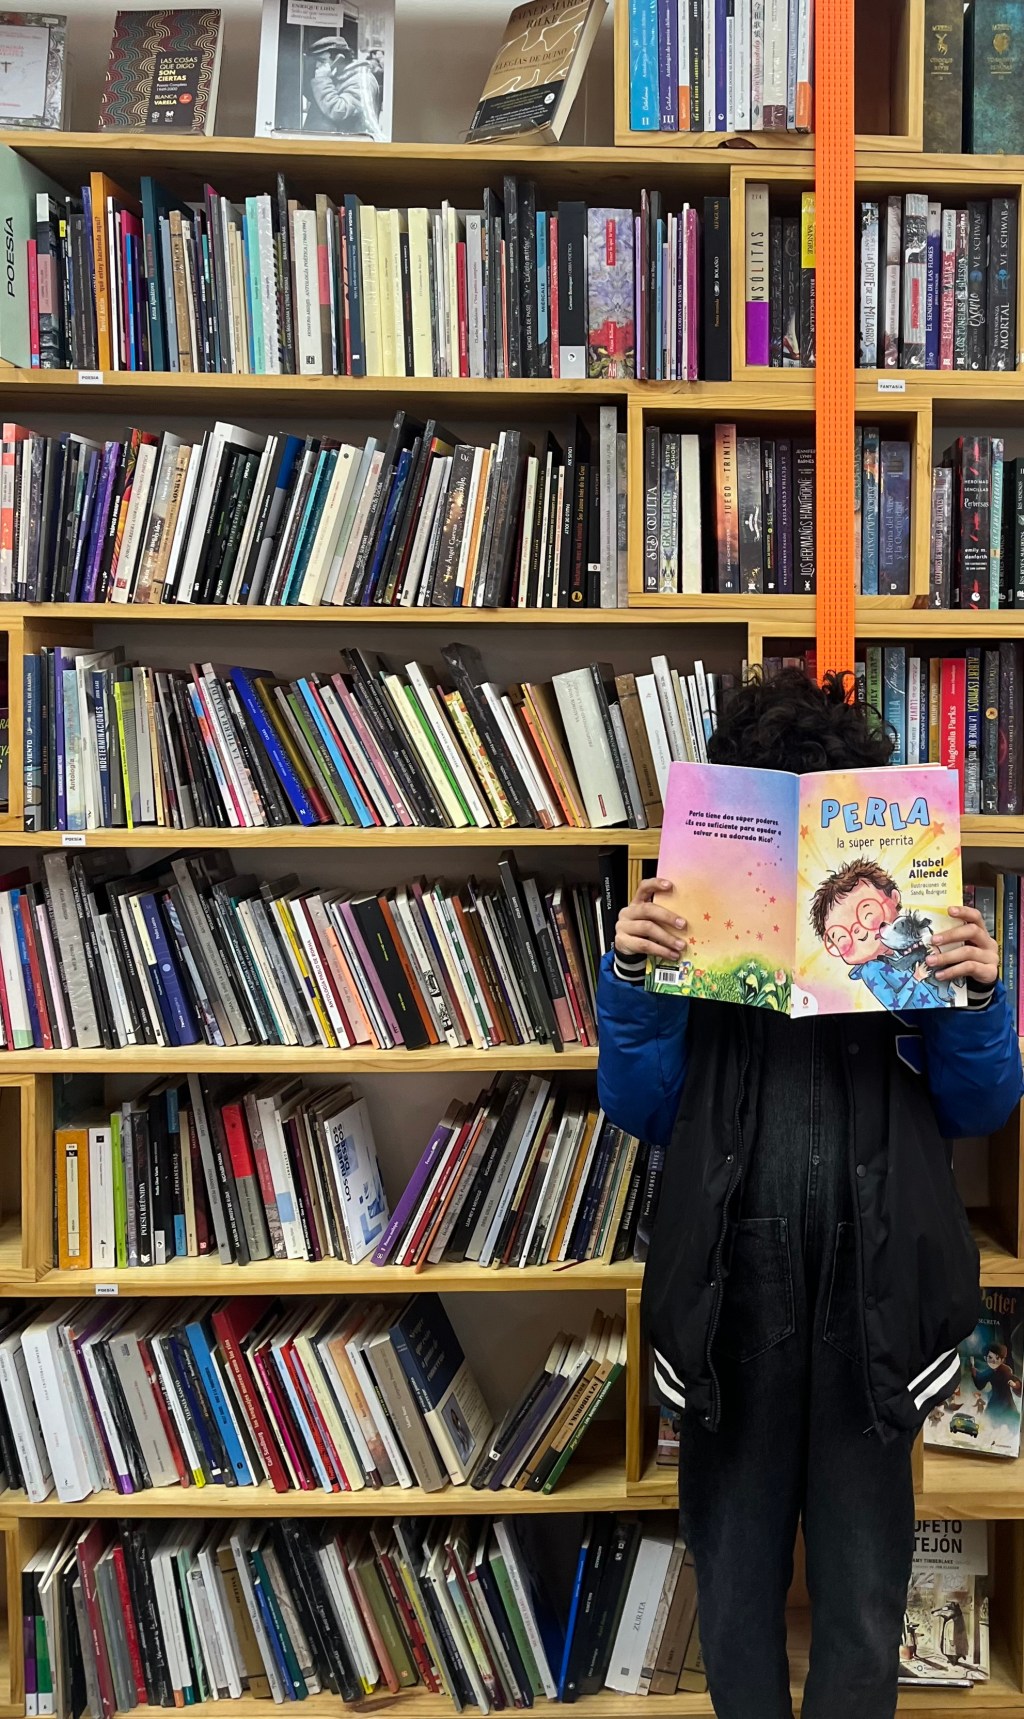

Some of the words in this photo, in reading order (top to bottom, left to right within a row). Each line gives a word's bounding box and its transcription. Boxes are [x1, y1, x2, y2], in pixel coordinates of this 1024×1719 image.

[495, 58, 527, 71] ELEGÍAS
[542, 49, 568, 60] DUINO
[7, 216, 15, 298] POESÍA
[863, 260, 874, 286] CORTE
[926, 283, 932, 291] DE
[863, 306, 874, 346] MILAGROS
[925, 323, 932, 331] EL
[998, 302, 1011, 349] MORTAL
[799, 477, 812, 519] HAWTHORNE
[992, 469, 1001, 508] BARBARIANS
[646, 486, 657, 530] OCULTA
[884, 496, 893, 513] Aire
[964, 498, 989, 509] Perversas
[659, 491, 673, 548] GRACELING
[894, 501, 903, 544] Oscuridad
[646, 535, 658, 560] SED
[800, 521, 812, 560] HERMANOS
[885, 530, 893, 553] Reina
[801, 562, 813, 576] LOS
[885, 554, 892, 564] La
[967, 656, 978, 680] ALBERT
[208, 679, 224, 713] BALDÍA
[921, 703, 925, 712] DE
[967, 681, 980, 711] ESPINOSA
[910, 699, 918, 722] LLUVIA
[921, 712, 925, 721] UN
[946, 705, 957, 729] Parks
[96, 706, 106, 771] INDETERMINACIONES
[220, 714, 235, 746] TIERRA
[261, 728, 269, 740] CASAS
[967, 723, 976, 738] NOCHE
[230, 747, 239, 759] LA
[946, 731, 958, 768] Magnolia
[967, 739, 976, 748] QUE
[967, 750, 976, 760] NOS
[67, 758, 76, 790] Antología
[967, 762, 977, 792] ESCUCHAMOS
[820, 796, 930, 833] PERLA
[729, 833, 756, 841] adorado
[757, 826, 777, 835] ayudar
[837, 838, 845, 849] la
[849, 838, 874, 850] súper
[880, 835, 914, 850] perrita
[909, 869, 949, 878] Allende
[912, 858, 944, 868] Isabel
[305, 939, 316, 957] ROKHA
[314, 964, 324, 980] PABLO
[319, 980, 335, 1008] ANTOLOGÍA
[632, 1174, 641, 1188] CITY
[647, 1170, 656, 1198] ALFONSO
[652, 1150, 660, 1168] REYES
[626, 1187, 638, 1211] WATERS
[622, 1210, 632, 1229] BLACK
[223, 1339, 231, 1350] ríos
[230, 1359, 240, 1373] como
[173, 1379, 185, 1398] SANTO
[236, 1373, 247, 1393] mueren
[180, 1398, 192, 1420] VIERNES
[243, 1393, 257, 1419] lenguajes
[568, 1380, 598, 1427] SZYMBORSKA
[256, 1431, 270, 1456] Sandburg
[264, 1455, 273, 1466] Carl
[631, 1600, 647, 1631] ZURITA
